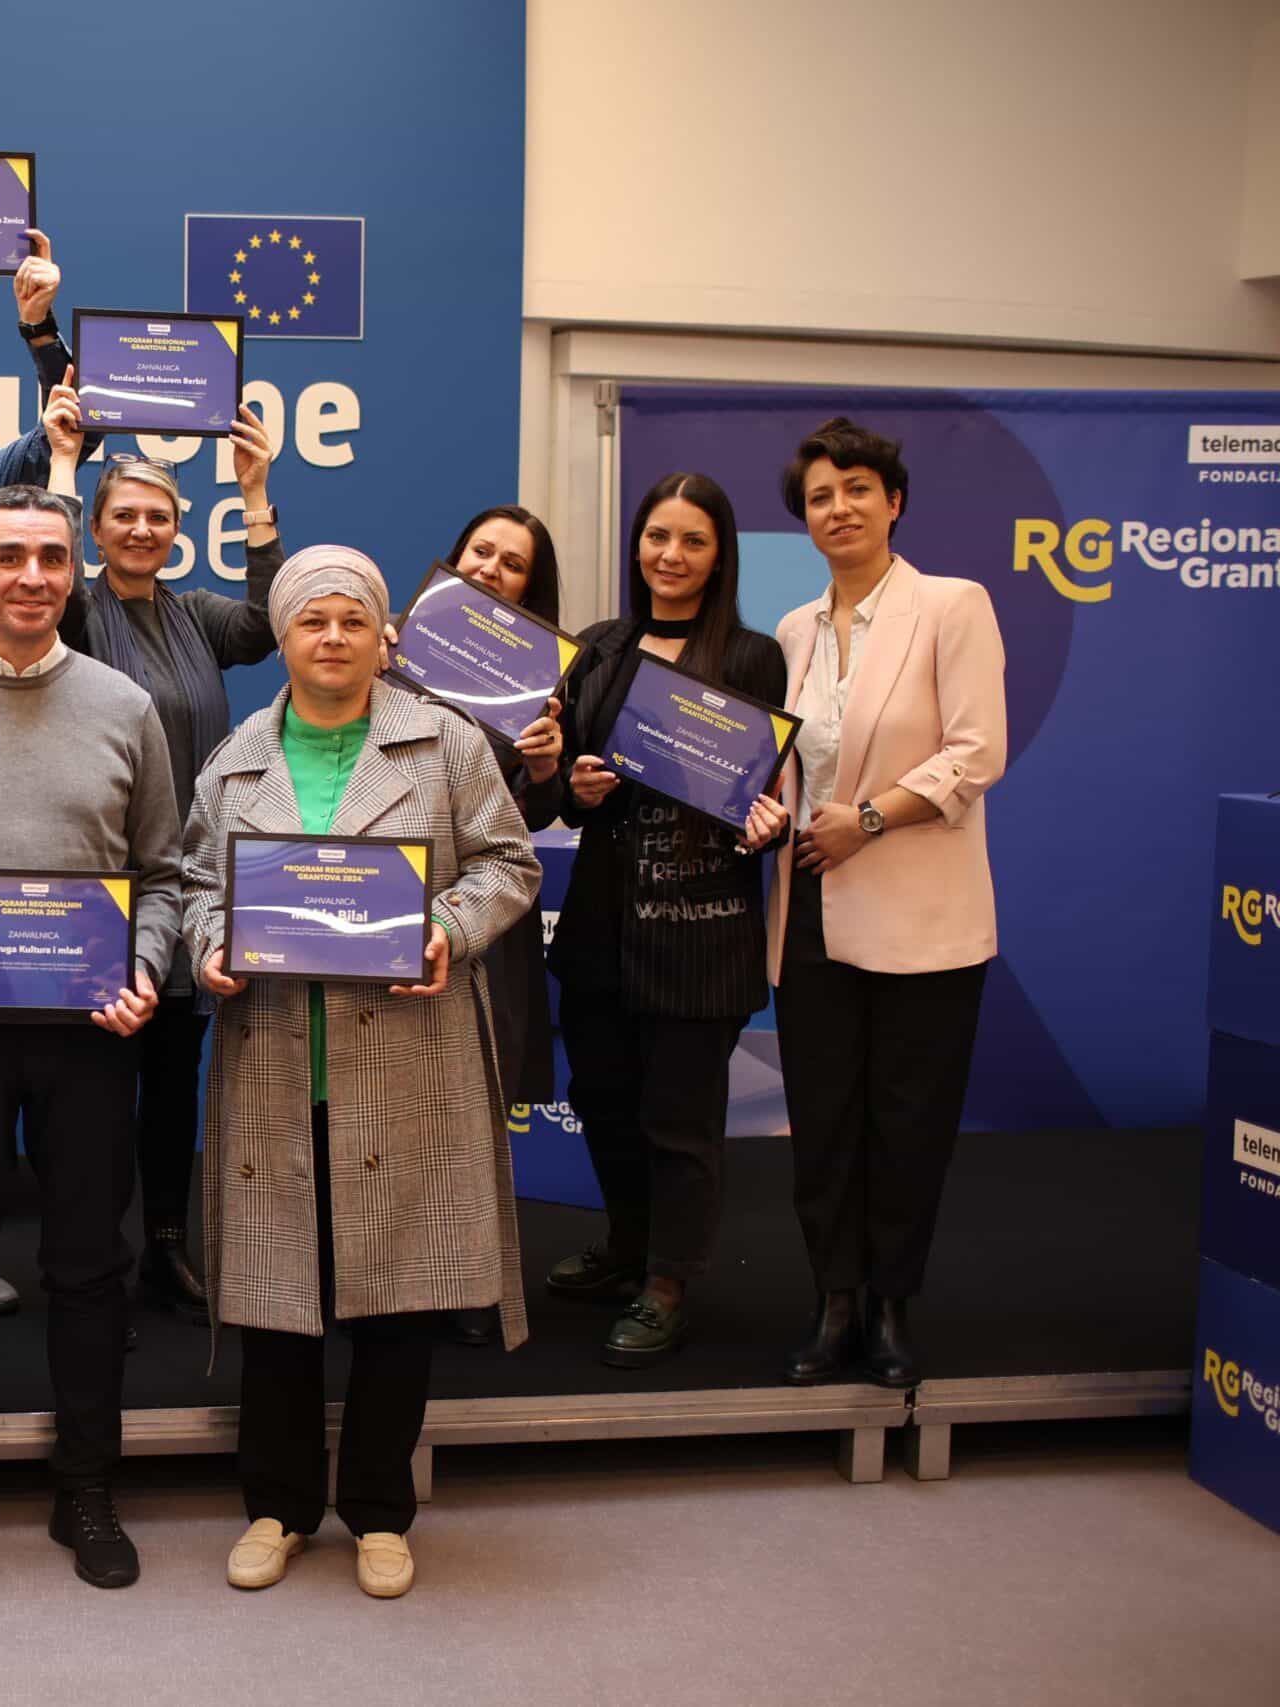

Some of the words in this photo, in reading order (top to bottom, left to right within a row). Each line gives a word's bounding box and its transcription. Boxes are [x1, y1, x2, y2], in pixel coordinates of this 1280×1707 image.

[109, 374, 145, 384] Fondacija
[1013, 518, 1112, 602] RG
[338, 909, 368, 922] Bilal
[1222, 885, 1263, 946] RG
[19, 944, 51, 955] Kultura
[58, 945, 83, 955] mladi
[1203, 1348, 1240, 1417] RG
